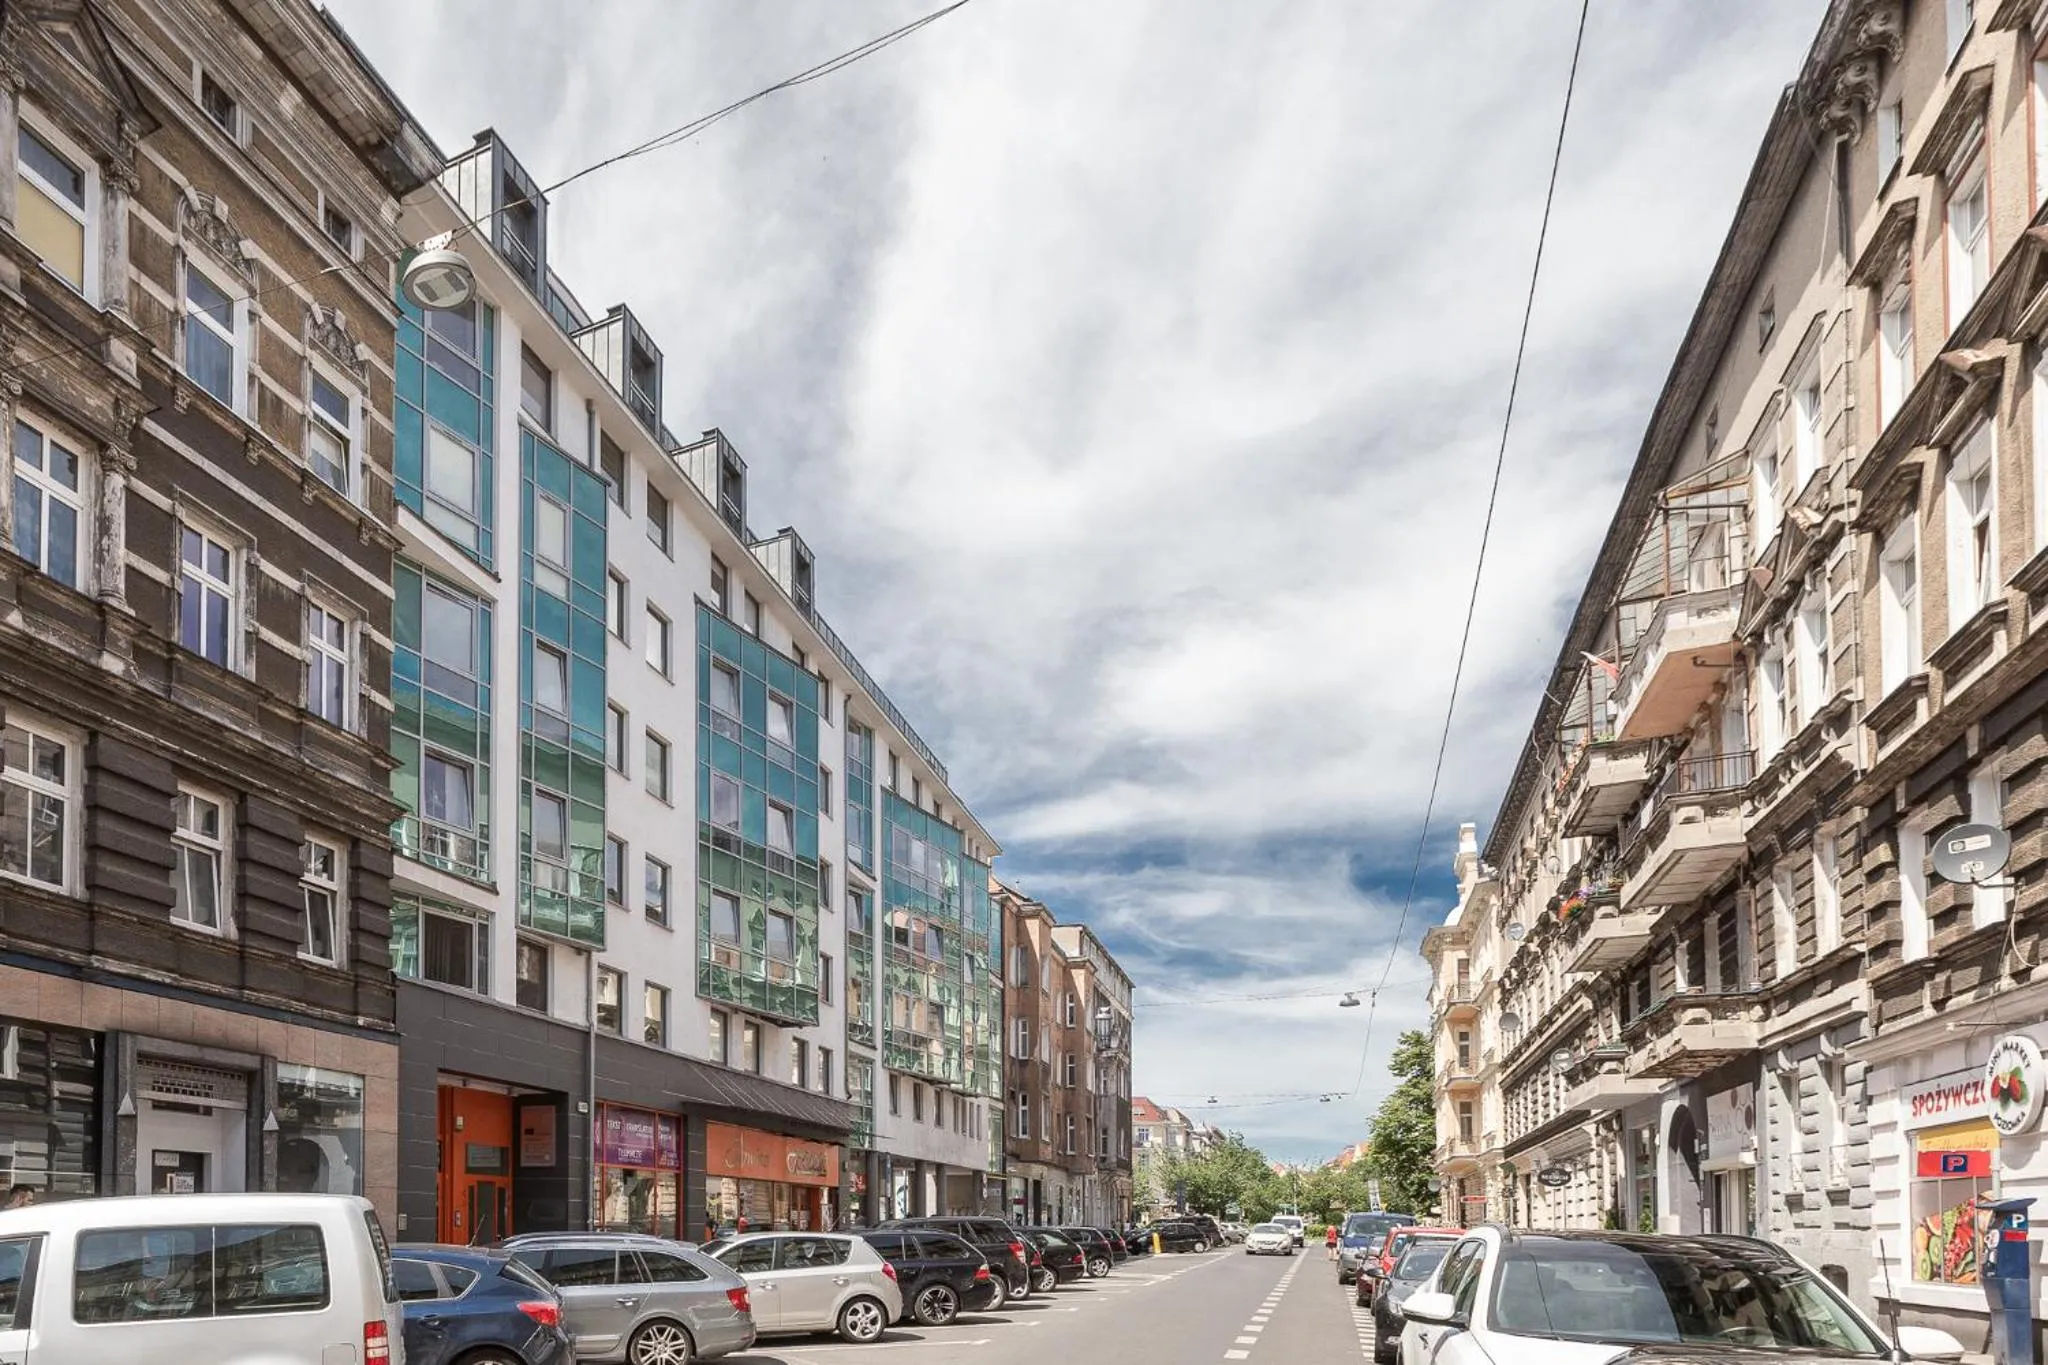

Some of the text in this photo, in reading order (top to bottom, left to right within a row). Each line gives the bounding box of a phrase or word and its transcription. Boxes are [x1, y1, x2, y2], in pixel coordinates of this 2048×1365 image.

[1989, 1041, 2031, 1076] MINI MARKET
[2012, 1213, 2025, 1228] P
